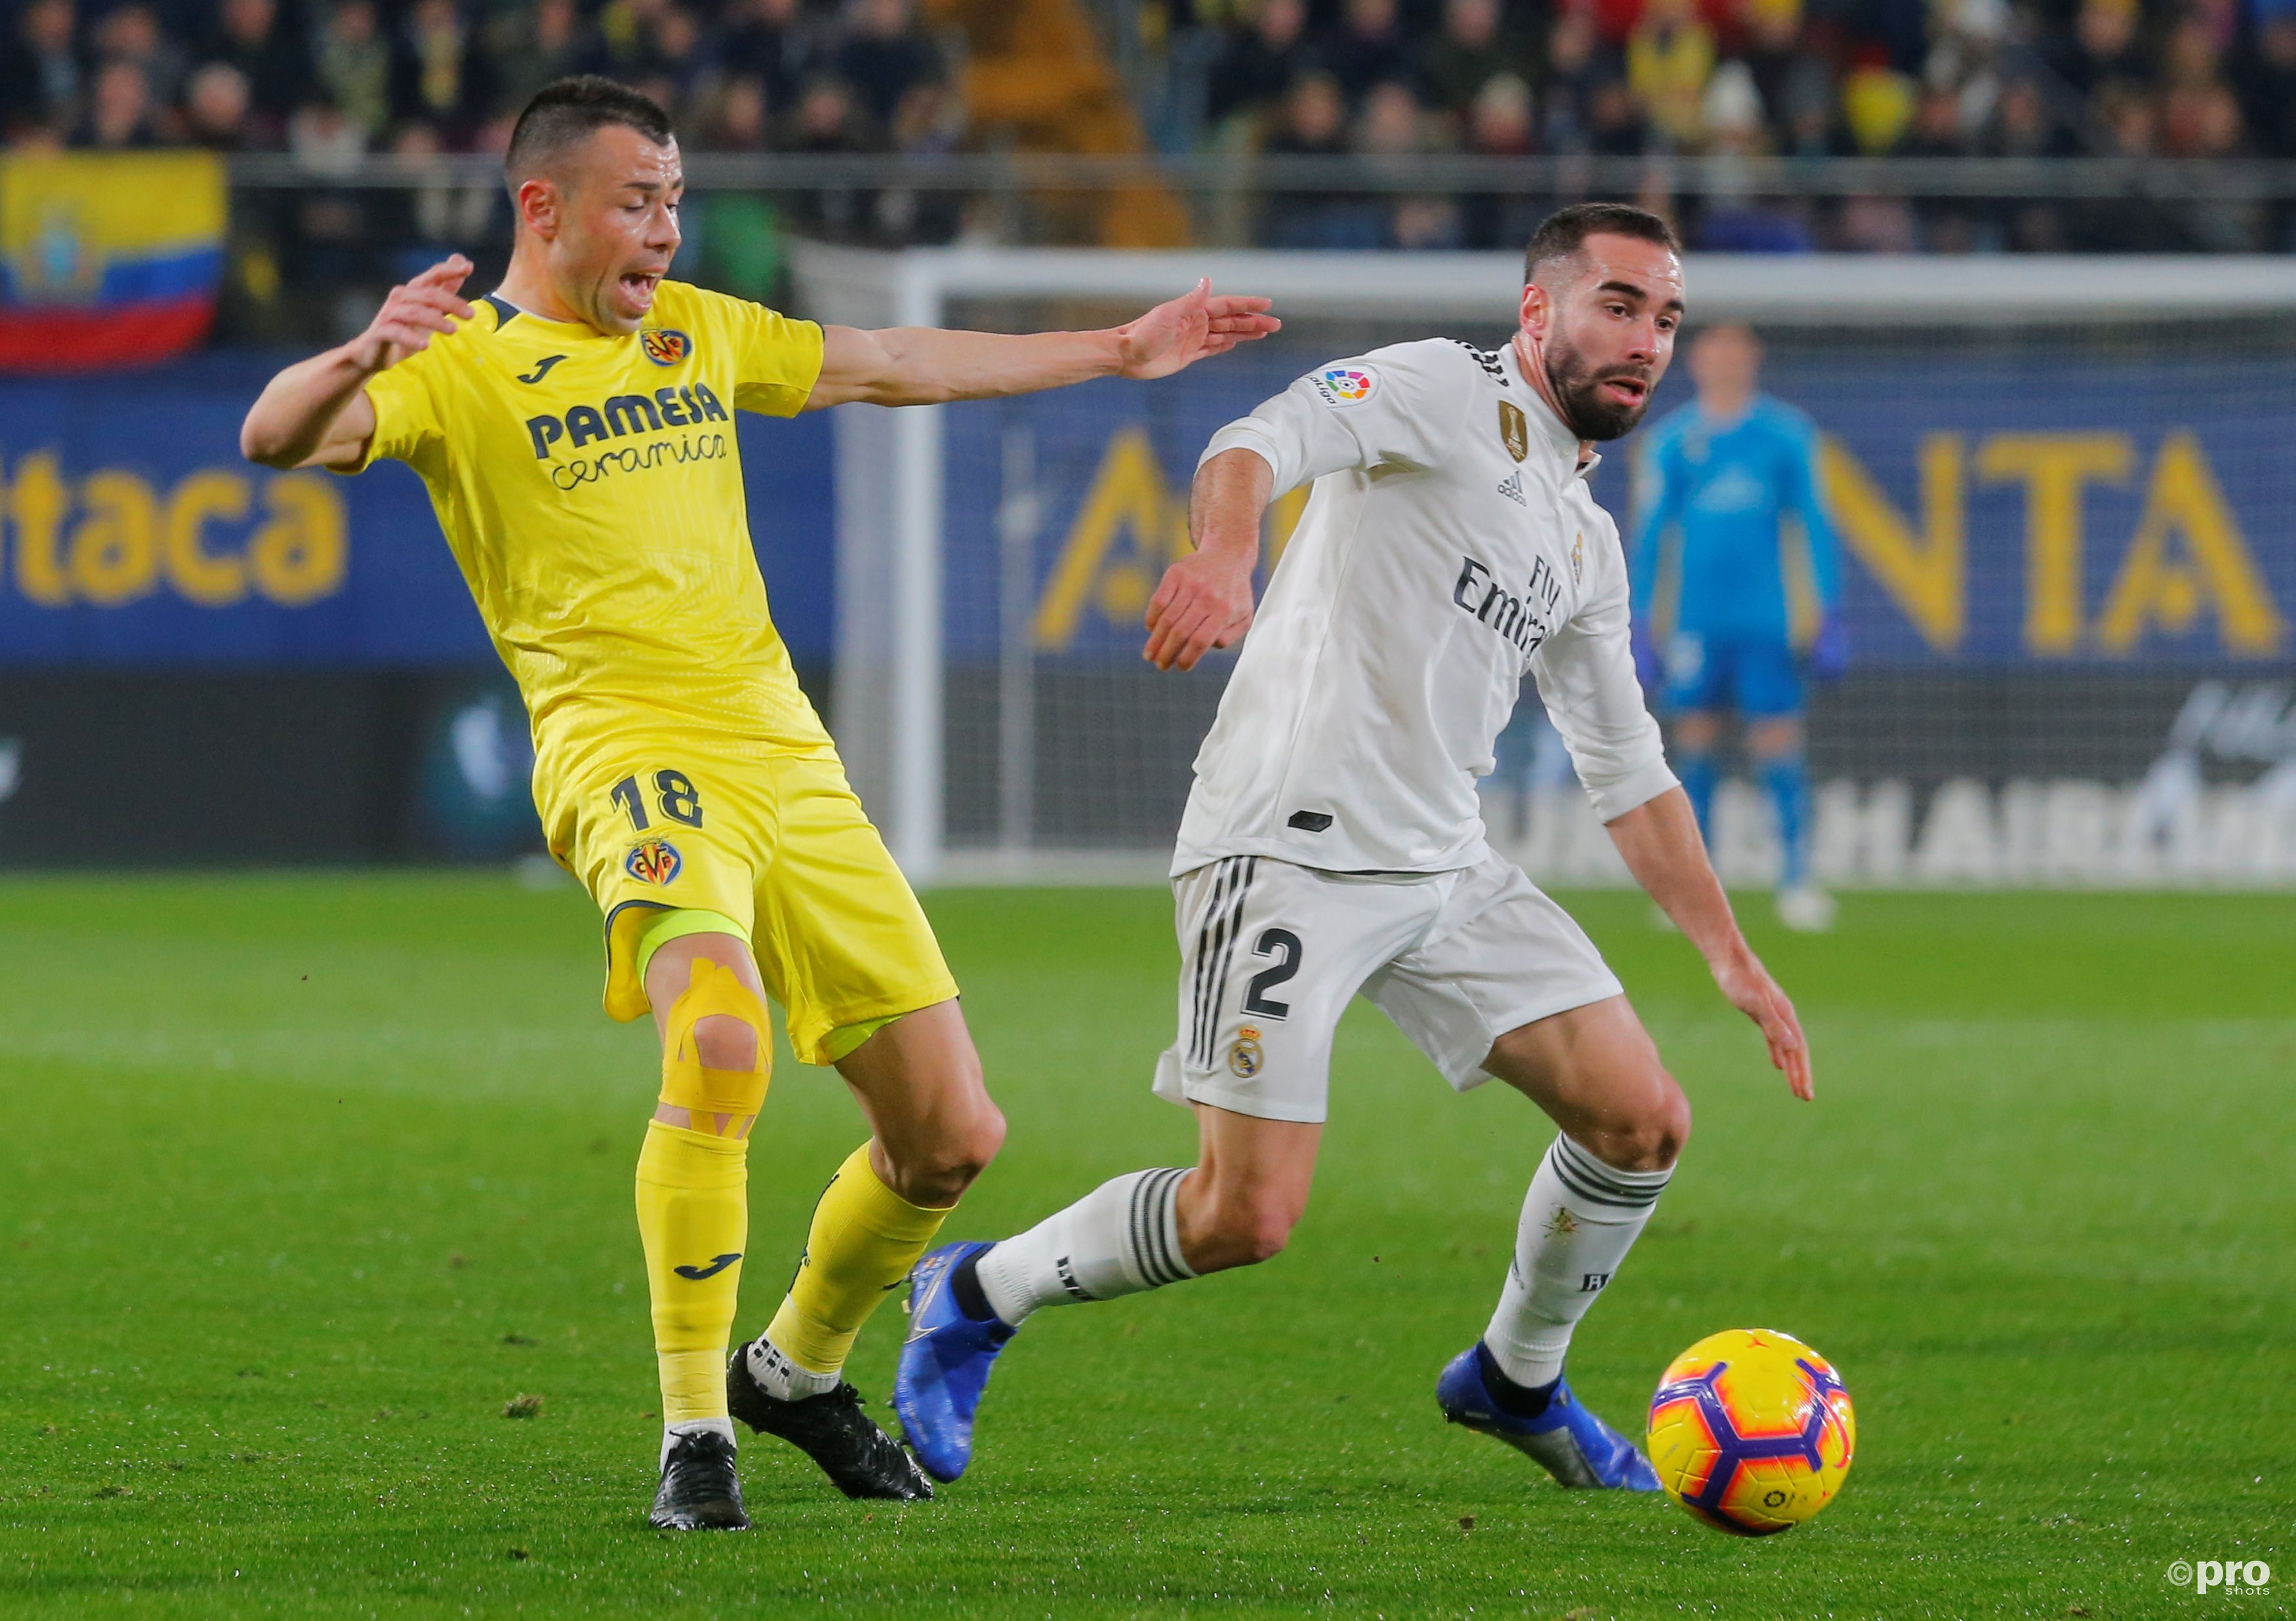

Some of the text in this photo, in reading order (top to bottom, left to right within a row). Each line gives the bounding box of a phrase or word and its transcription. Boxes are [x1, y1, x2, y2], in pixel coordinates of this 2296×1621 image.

[525, 382, 728, 459] PAMESA
[552, 434, 726, 490] ceramica
[0, 448, 348, 606] taca
[1453, 555, 1549, 658] Emira
[1528, 554, 1561, 615] Fly
[609, 769, 703, 833] 18
[1240, 928, 1302, 1022] 2
